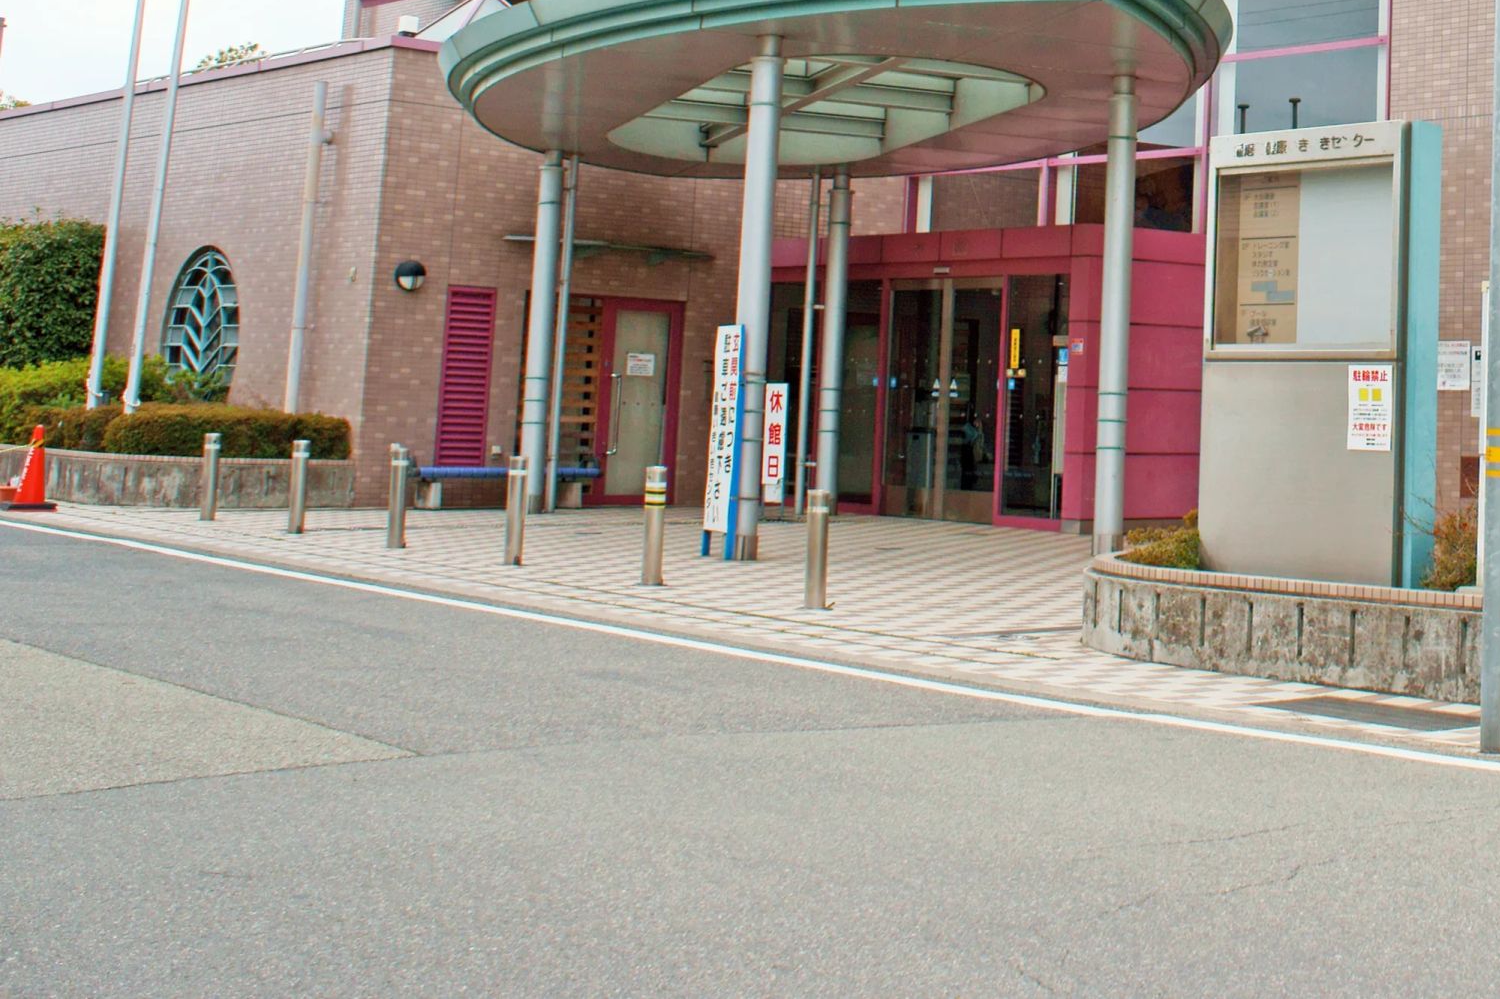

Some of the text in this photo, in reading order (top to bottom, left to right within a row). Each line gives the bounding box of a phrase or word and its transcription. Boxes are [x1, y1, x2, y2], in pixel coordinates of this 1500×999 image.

[1352, 370, 1388, 382] 駐輪禁止
[768, 390, 783, 478] 休館日
